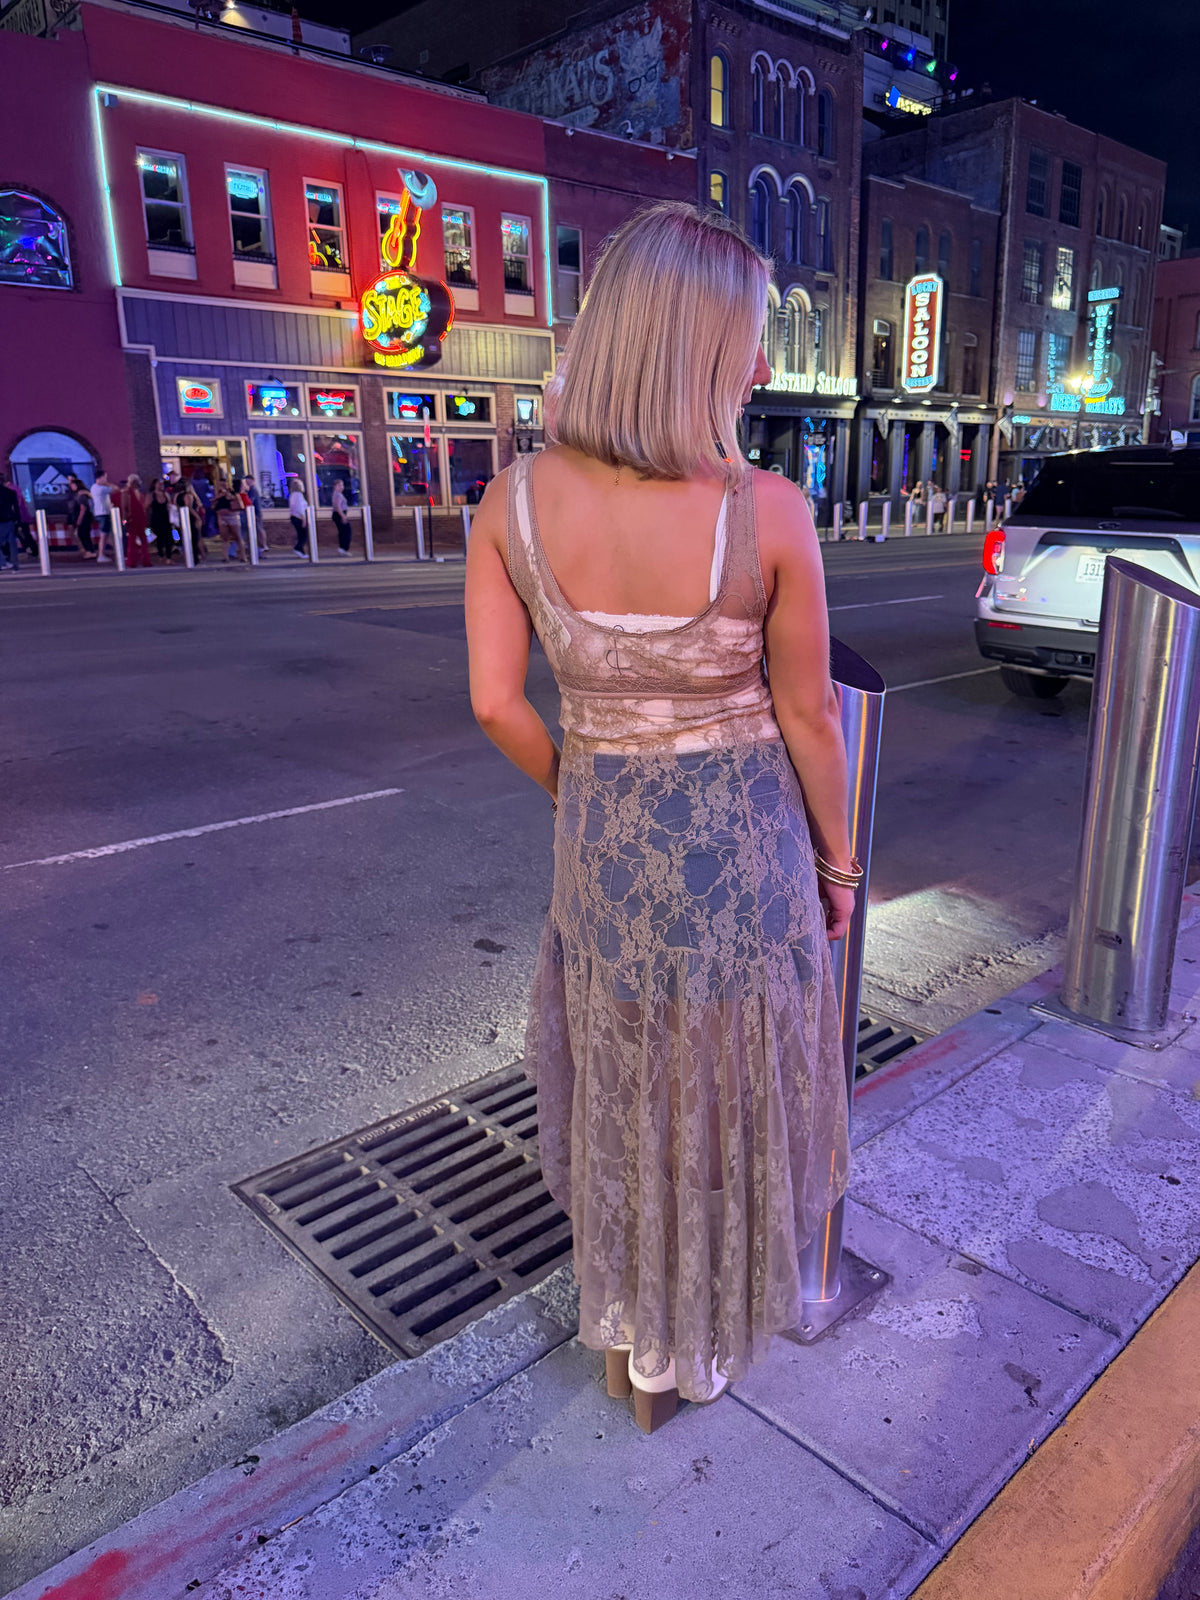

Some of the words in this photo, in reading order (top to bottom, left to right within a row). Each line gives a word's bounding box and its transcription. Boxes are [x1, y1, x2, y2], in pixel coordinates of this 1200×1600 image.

[361, 286, 426, 341] STAGE
[911, 292, 931, 378] SALOON
[1092, 303, 1111, 382] WHISKEY
[816, 370, 857, 396] SALOON
